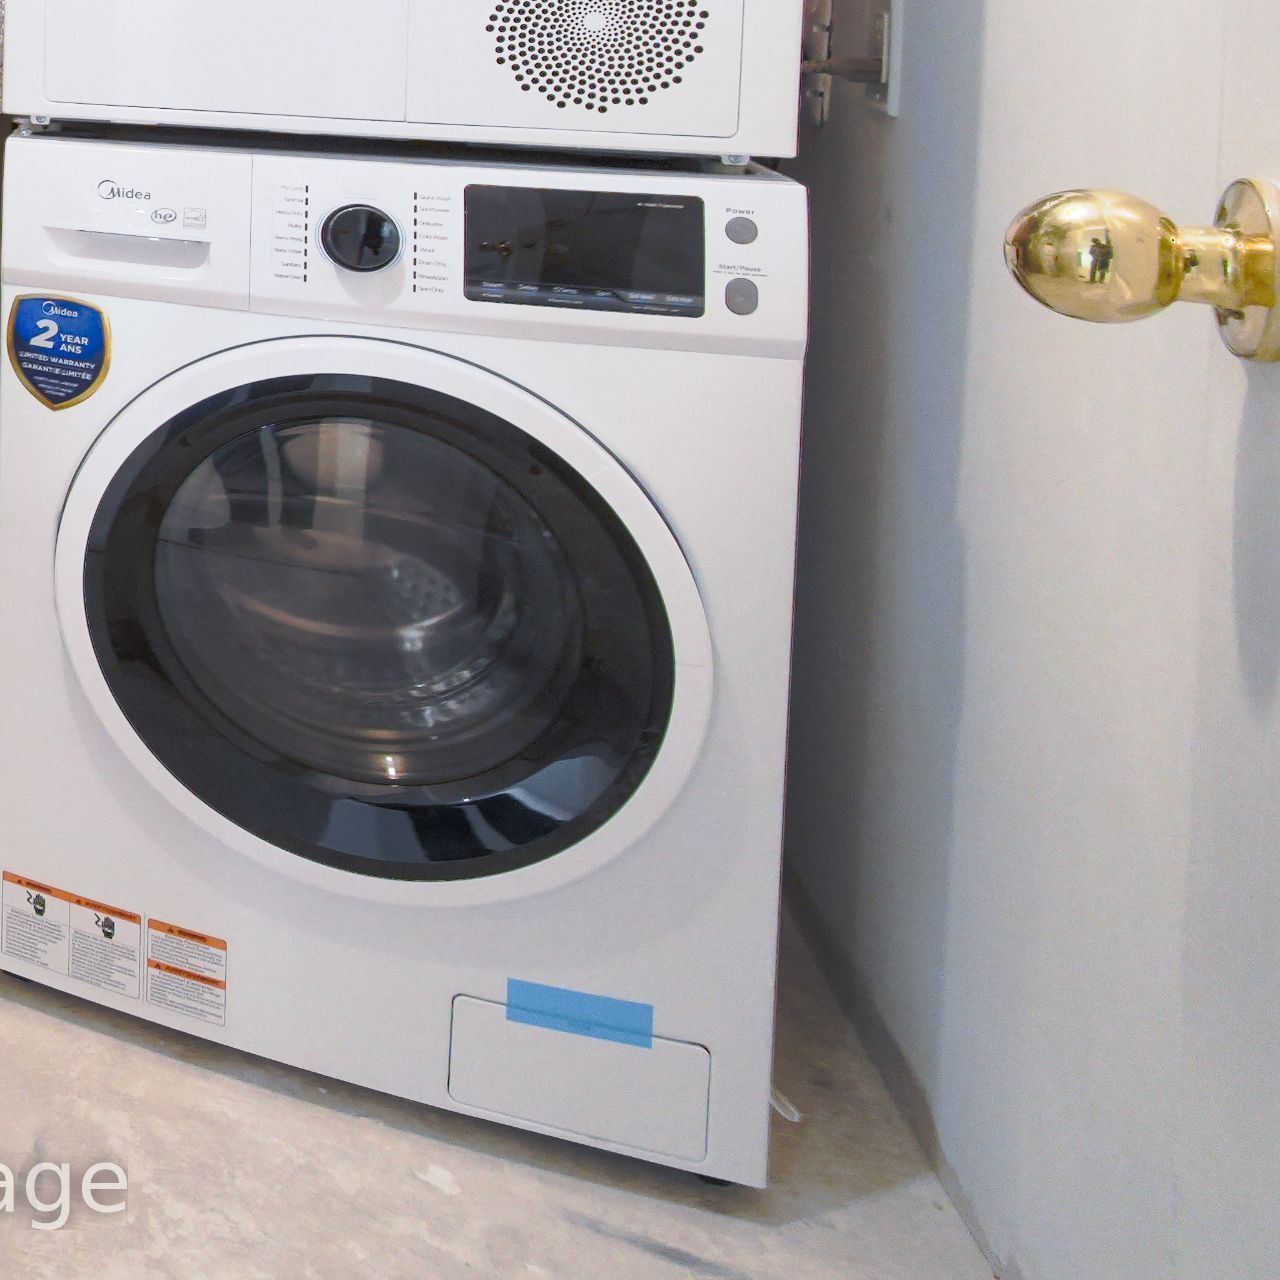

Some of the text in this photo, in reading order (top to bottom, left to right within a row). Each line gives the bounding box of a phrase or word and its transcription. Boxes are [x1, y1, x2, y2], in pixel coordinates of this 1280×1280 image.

[98, 180, 151, 200] Midea
[726, 207, 755, 215] Power
[718, 263, 761, 272] Start/Pause
[42, 301, 78, 317] Midea
[30, 318, 88, 349] 2 YEAR
[60, 344, 81, 354] ANS
[19, 351, 95, 369] LIMITED WARRANTY
[22, 362, 59, 374] GARANTIE
